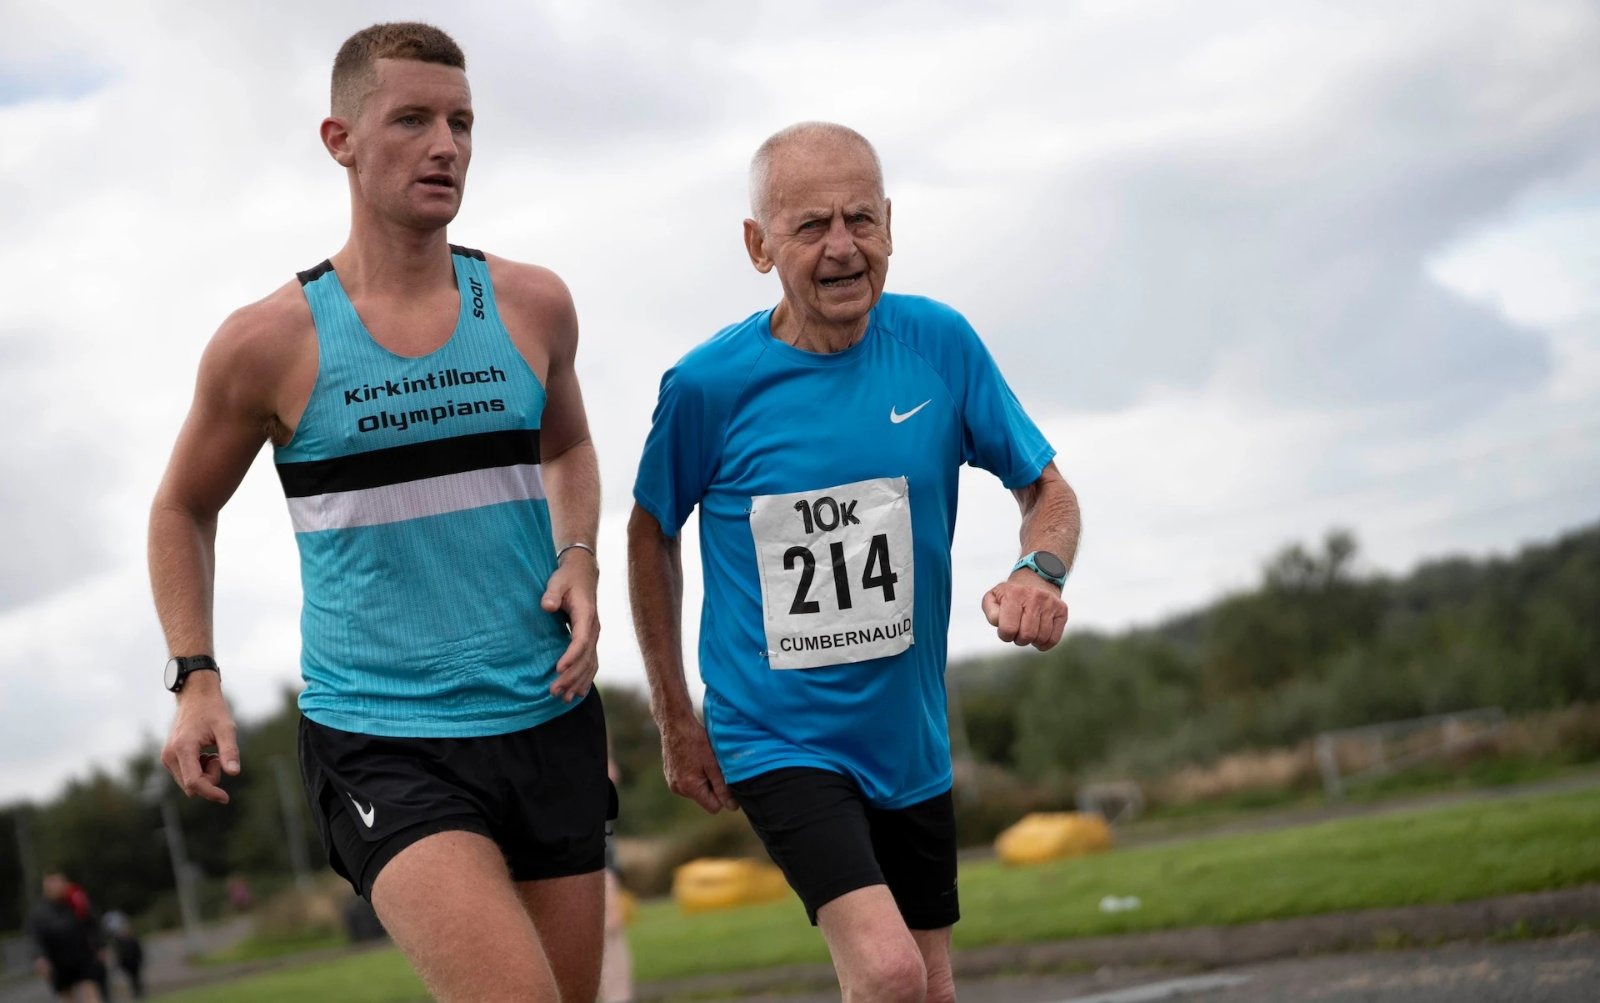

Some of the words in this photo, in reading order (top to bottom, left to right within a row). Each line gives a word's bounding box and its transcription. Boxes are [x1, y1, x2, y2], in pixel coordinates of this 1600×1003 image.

[469, 277, 485, 320] soar
[344, 365, 507, 405] Kirkintilloch
[358, 398, 506, 432] Olympians
[793, 496, 860, 534] 10K
[783, 533, 898, 615] 214
[780, 618, 911, 652] CUMBERNAULD
